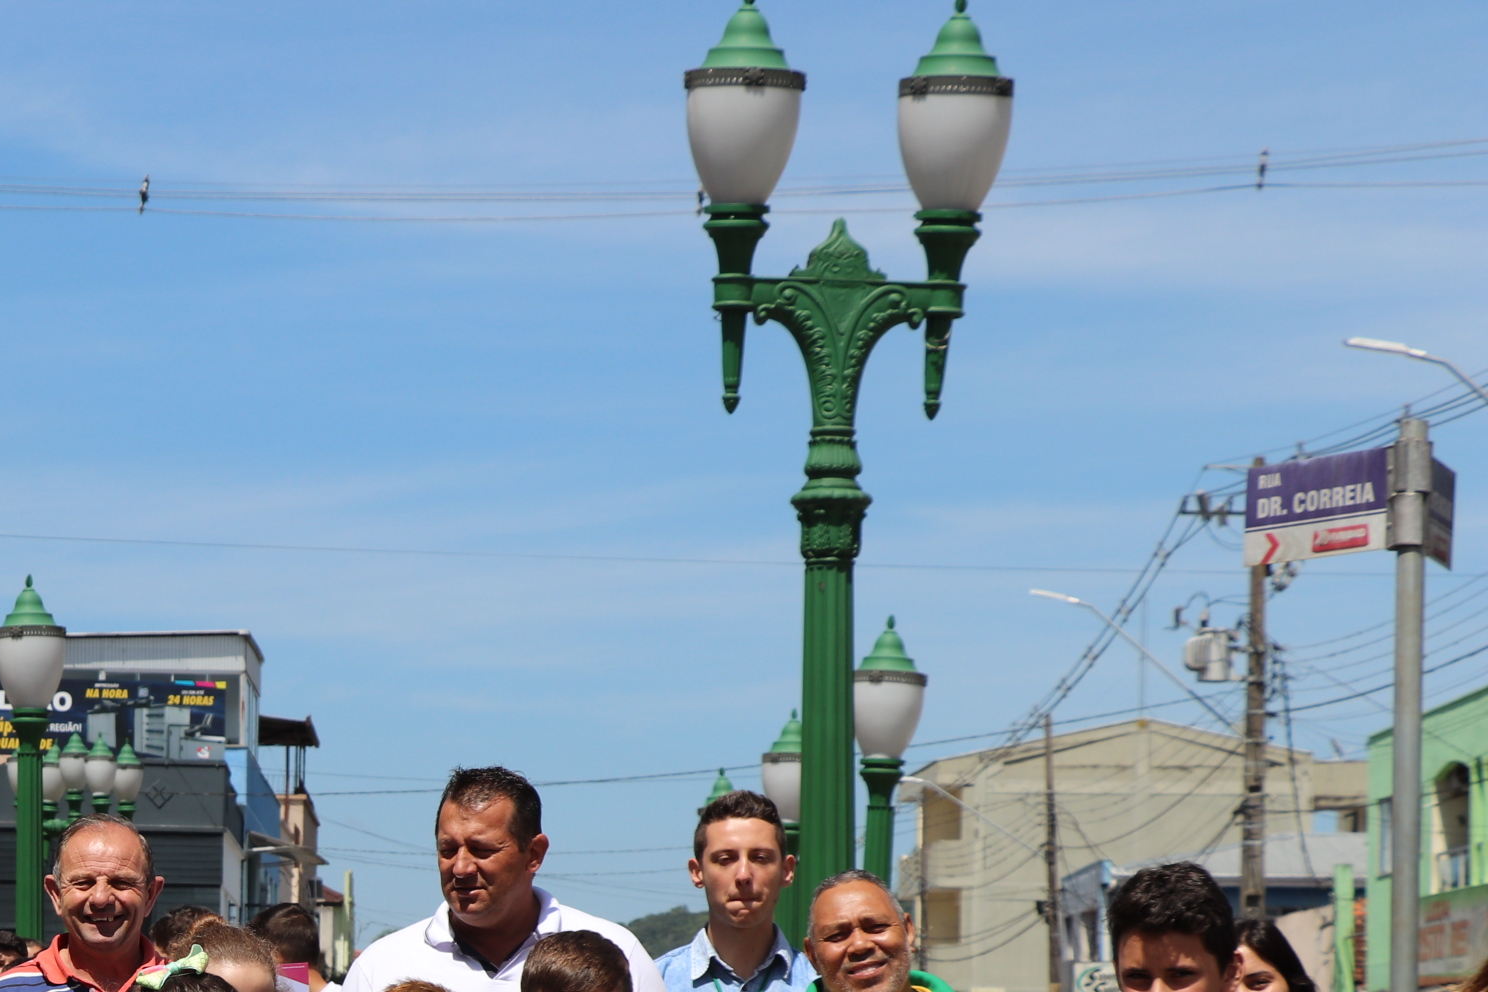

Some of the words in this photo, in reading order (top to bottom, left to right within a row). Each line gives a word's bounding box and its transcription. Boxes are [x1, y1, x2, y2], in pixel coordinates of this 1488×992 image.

[1257, 472, 1282, 490] RUA
[1256, 496, 1288, 519] DR.
[1292, 482, 1375, 514] CORREIA
[86, 688, 100, 698] NA
[102, 688, 128, 699] HORA
[167, 695, 180, 705] 24
[182, 696, 214, 706] HORAS
[50, 721, 82, 732] REGIÃO!
